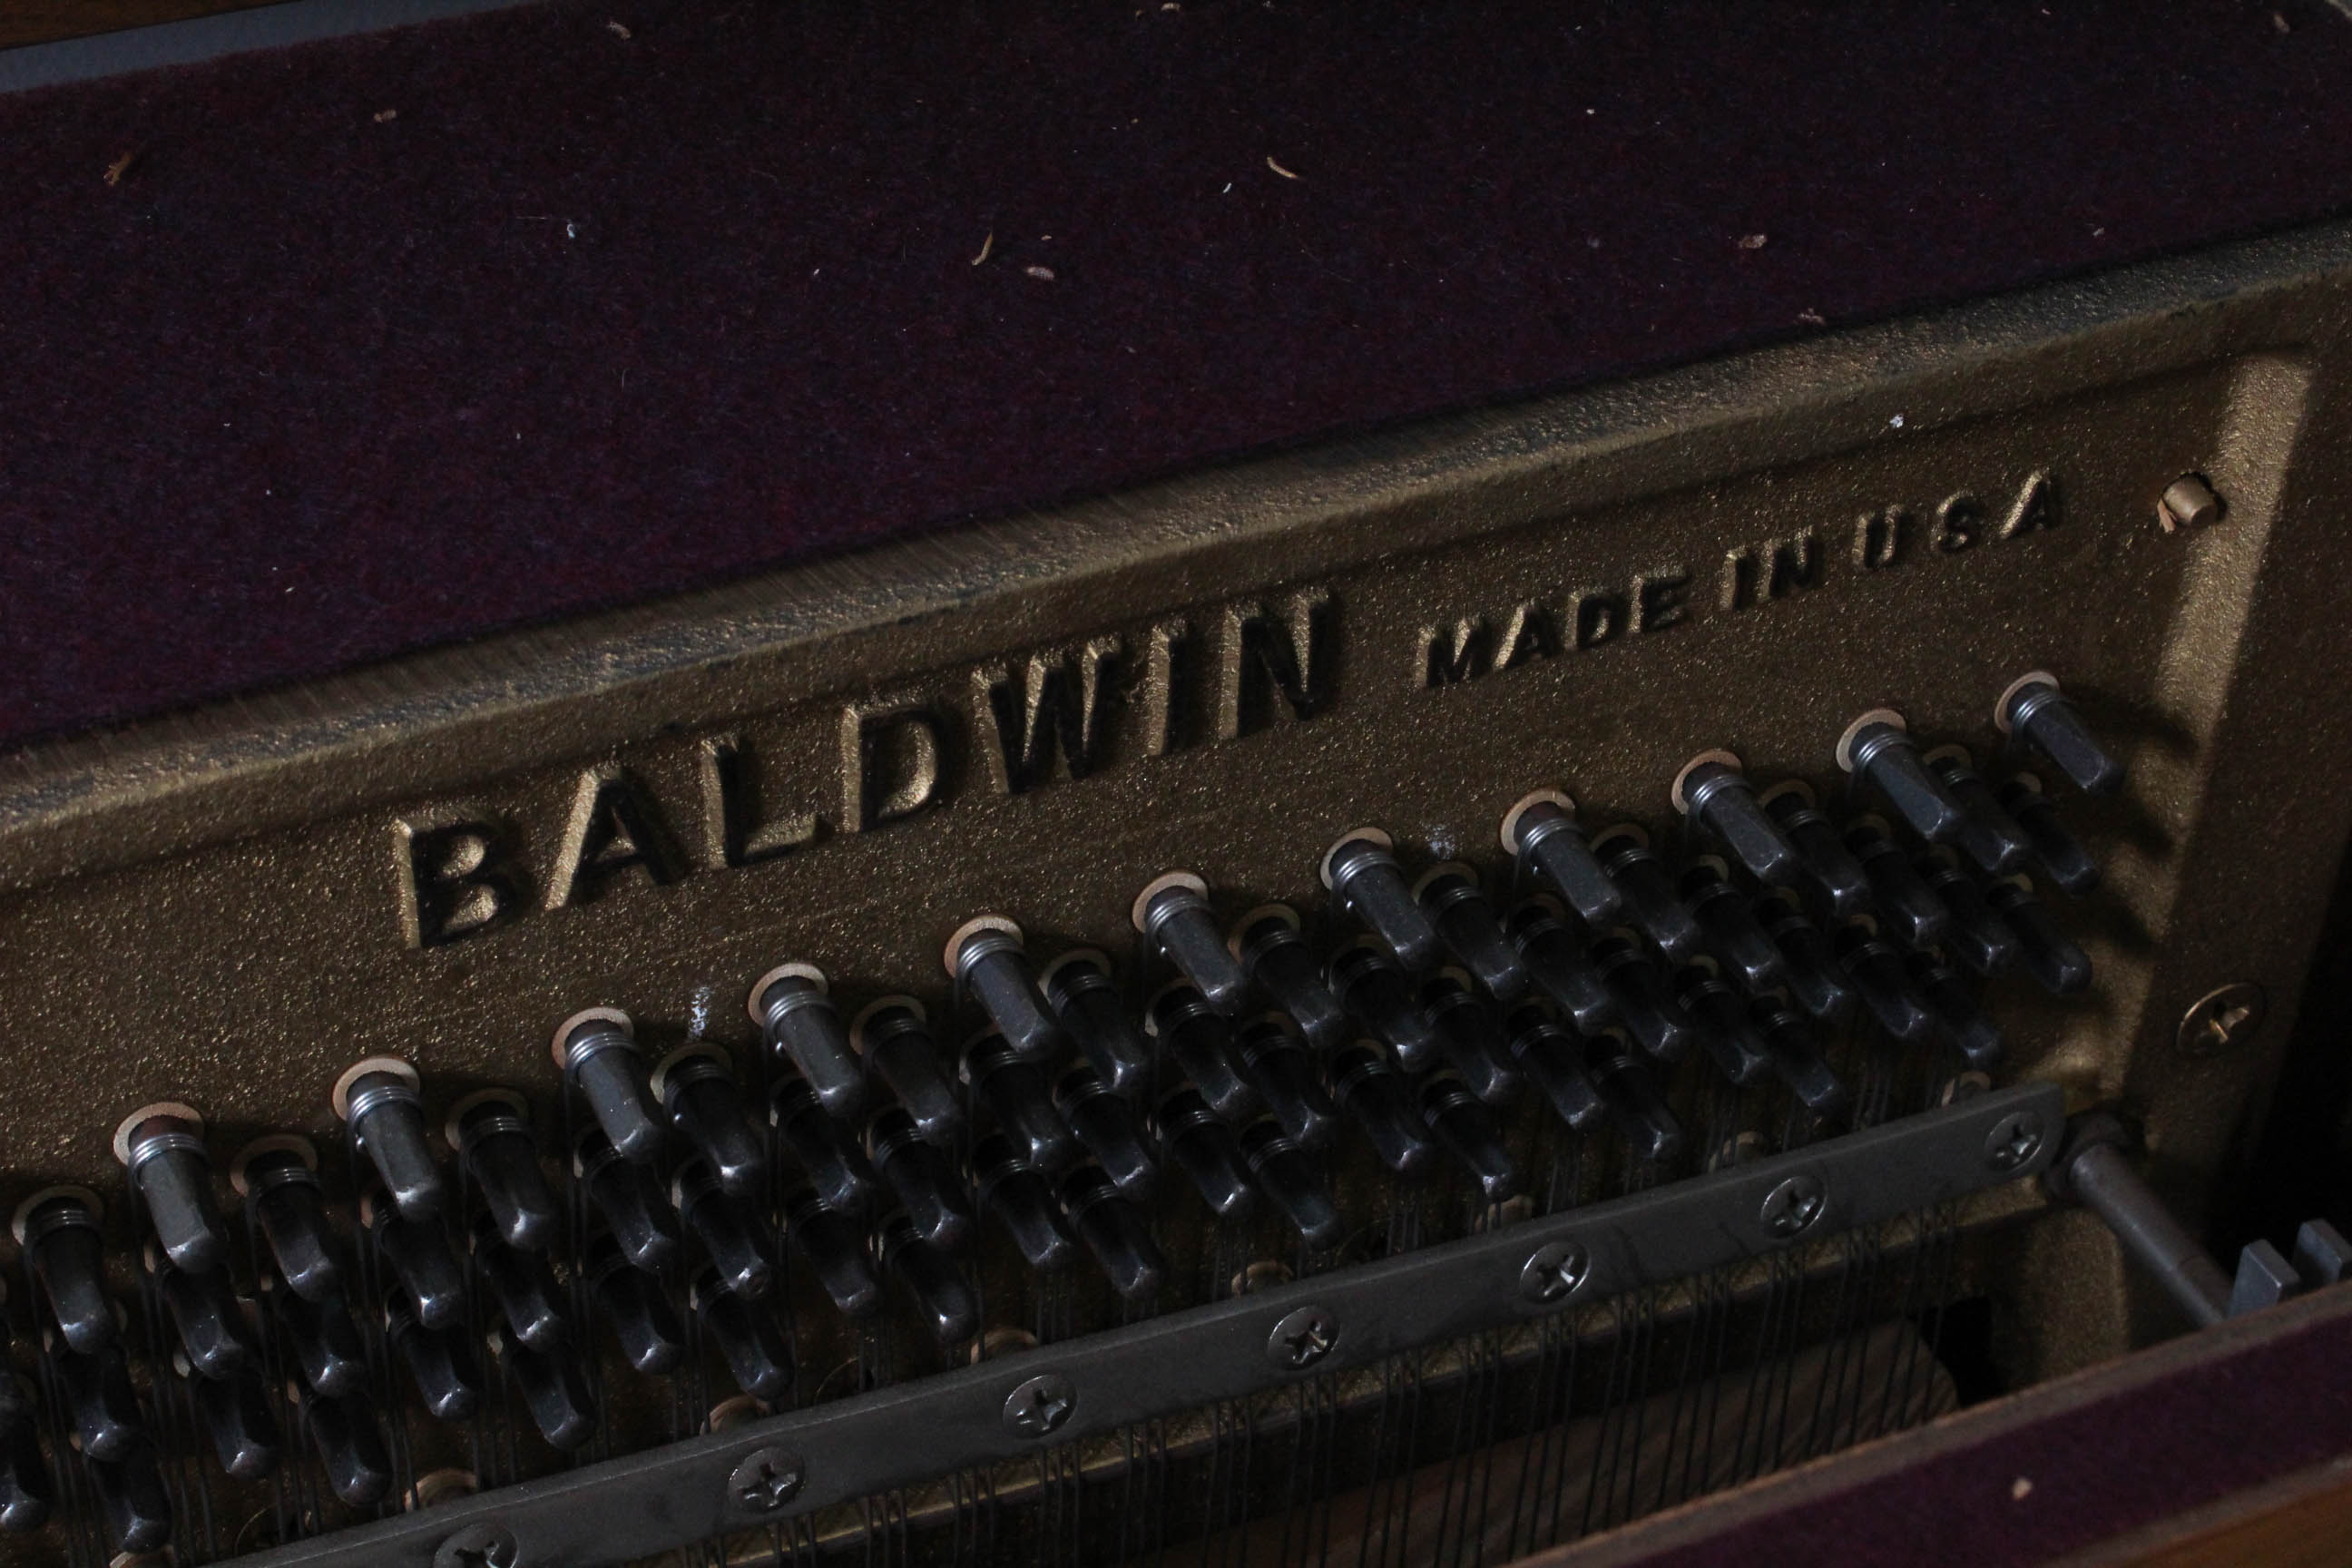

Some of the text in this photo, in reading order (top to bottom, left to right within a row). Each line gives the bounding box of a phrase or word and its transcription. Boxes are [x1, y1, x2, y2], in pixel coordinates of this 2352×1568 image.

[1412, 564, 1693, 690] MADE
[1720, 524, 1820, 612] IN
[392, 584, 1336, 949] BALDWIN
